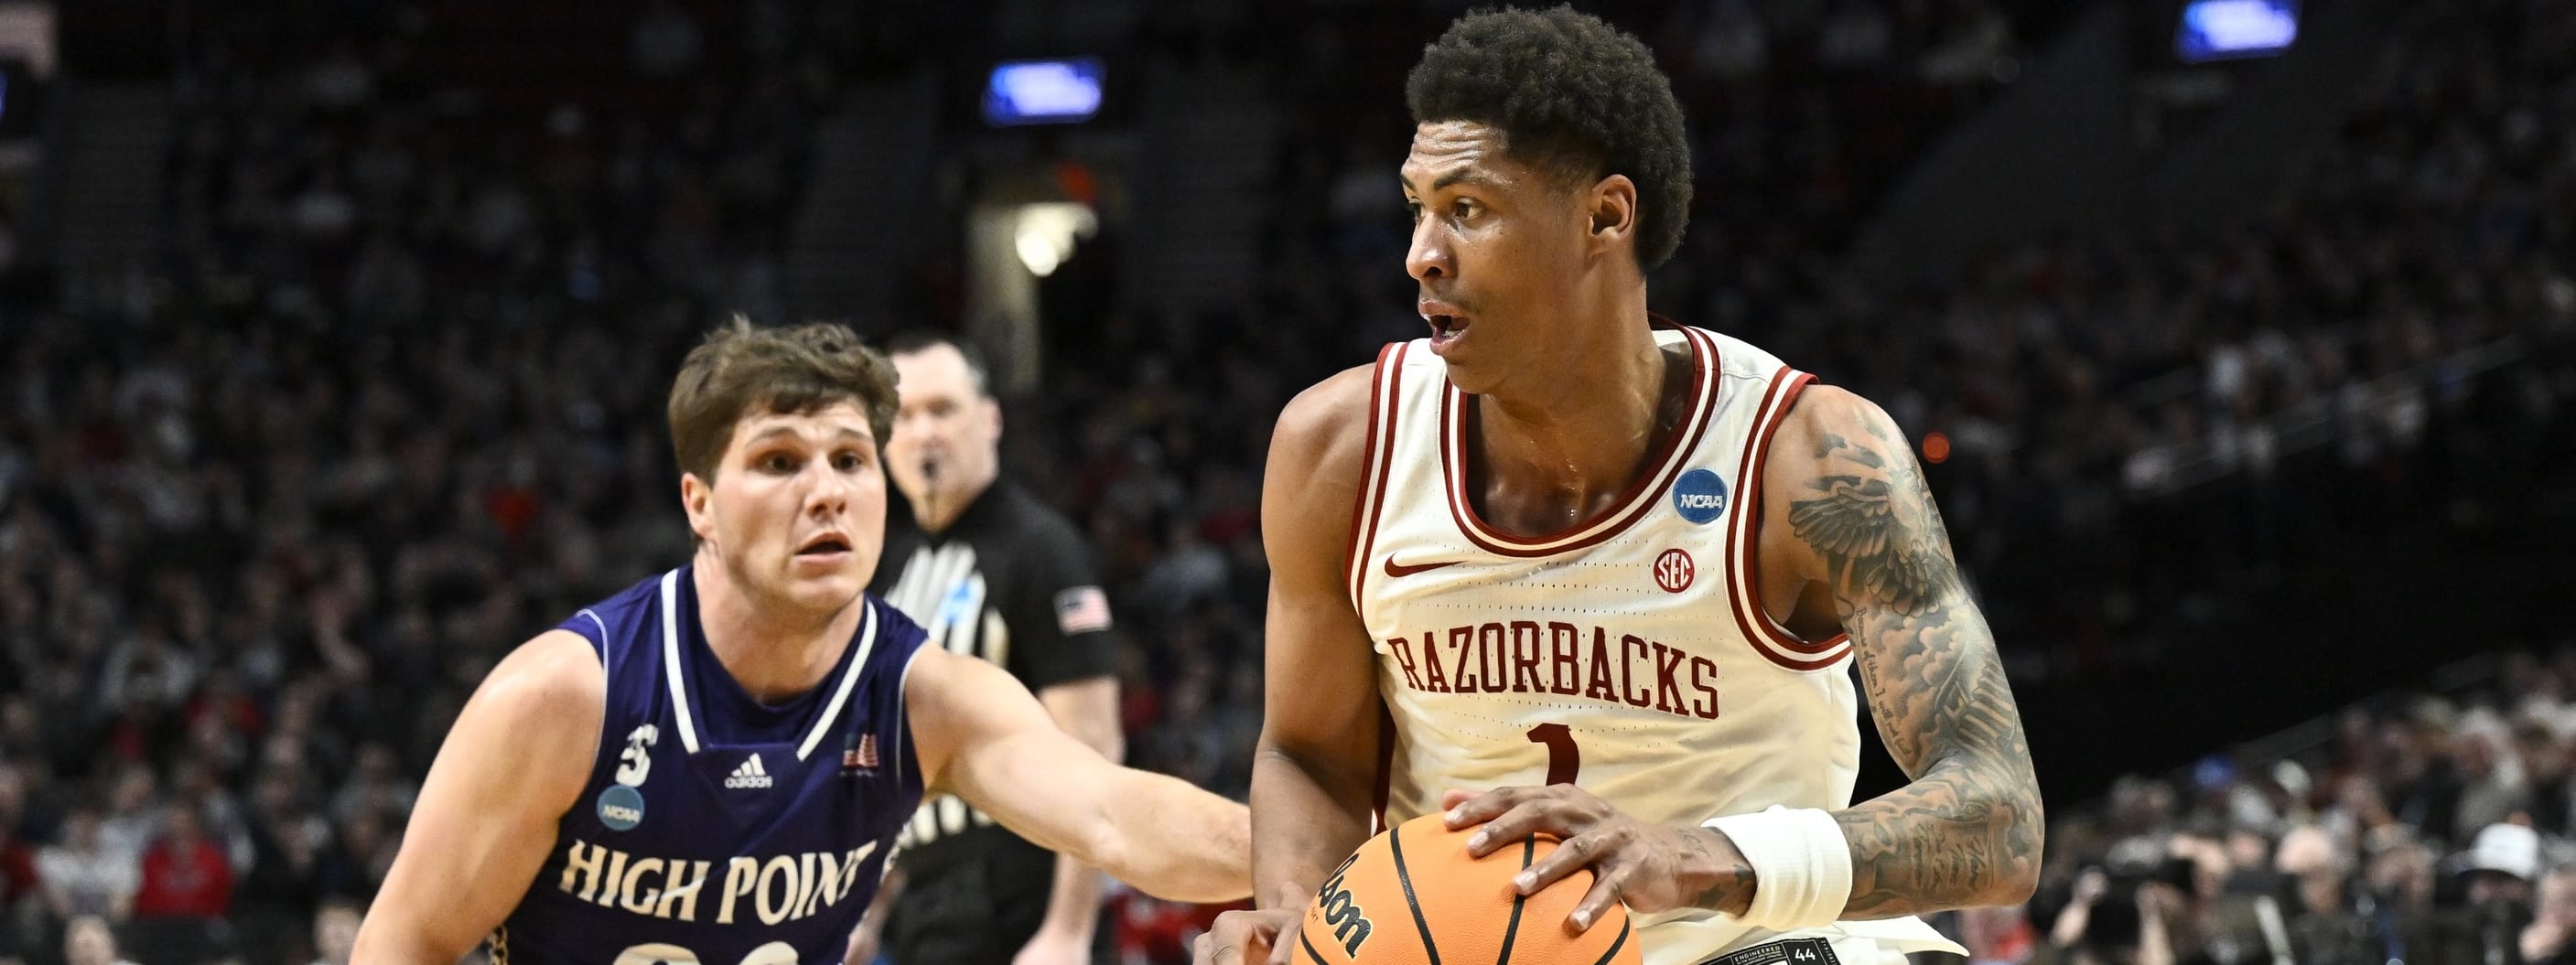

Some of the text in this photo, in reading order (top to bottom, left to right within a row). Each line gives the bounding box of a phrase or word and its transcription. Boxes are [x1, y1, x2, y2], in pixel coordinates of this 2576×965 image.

[1680, 494, 1723, 509] NCAA
[1658, 552, 1691, 590] SEC
[1386, 620, 1720, 720] RAZORBACKS
[1526, 723, 1579, 787] 1
[724, 775, 773, 789] adidas
[602, 804, 641, 823] NCAA
[558, 839, 878, 926] HIGH POINT
[1318, 852, 1372, 960] lson
[1734, 946, 1781, 962] ENGINEERED
[1795, 948, 1816, 961] 44
